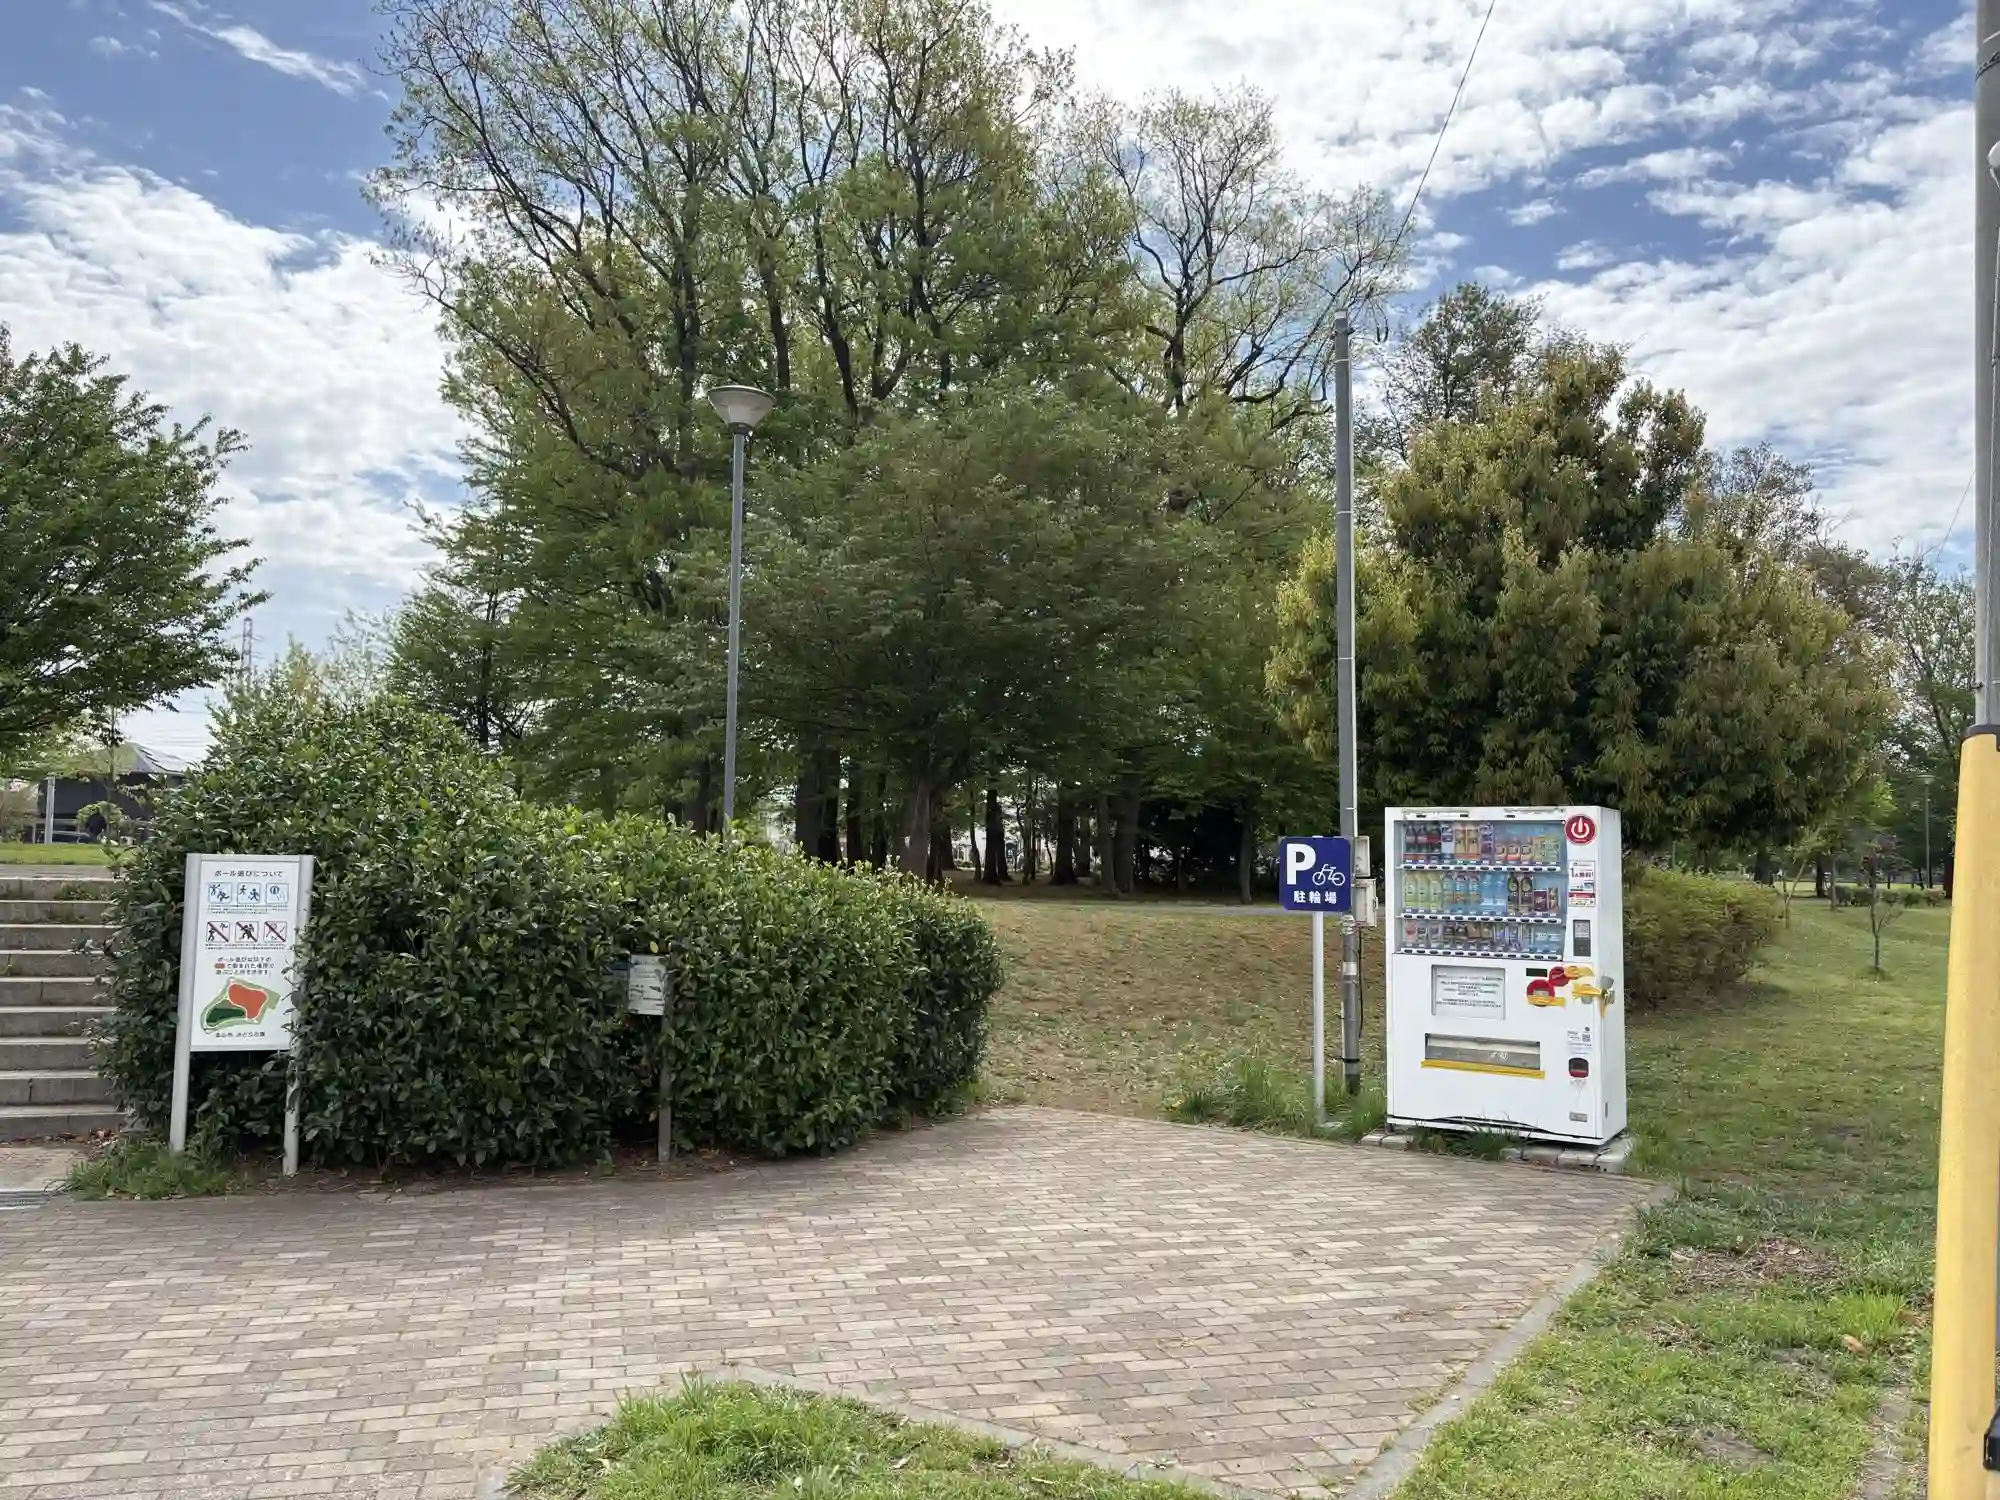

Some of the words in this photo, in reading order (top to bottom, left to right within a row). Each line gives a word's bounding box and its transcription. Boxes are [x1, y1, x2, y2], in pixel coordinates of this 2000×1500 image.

[1286, 843, 1316, 885] P
[214, 870, 284, 878] ボール遊びについて
[1293, 890, 1338, 905] 駐輪場
